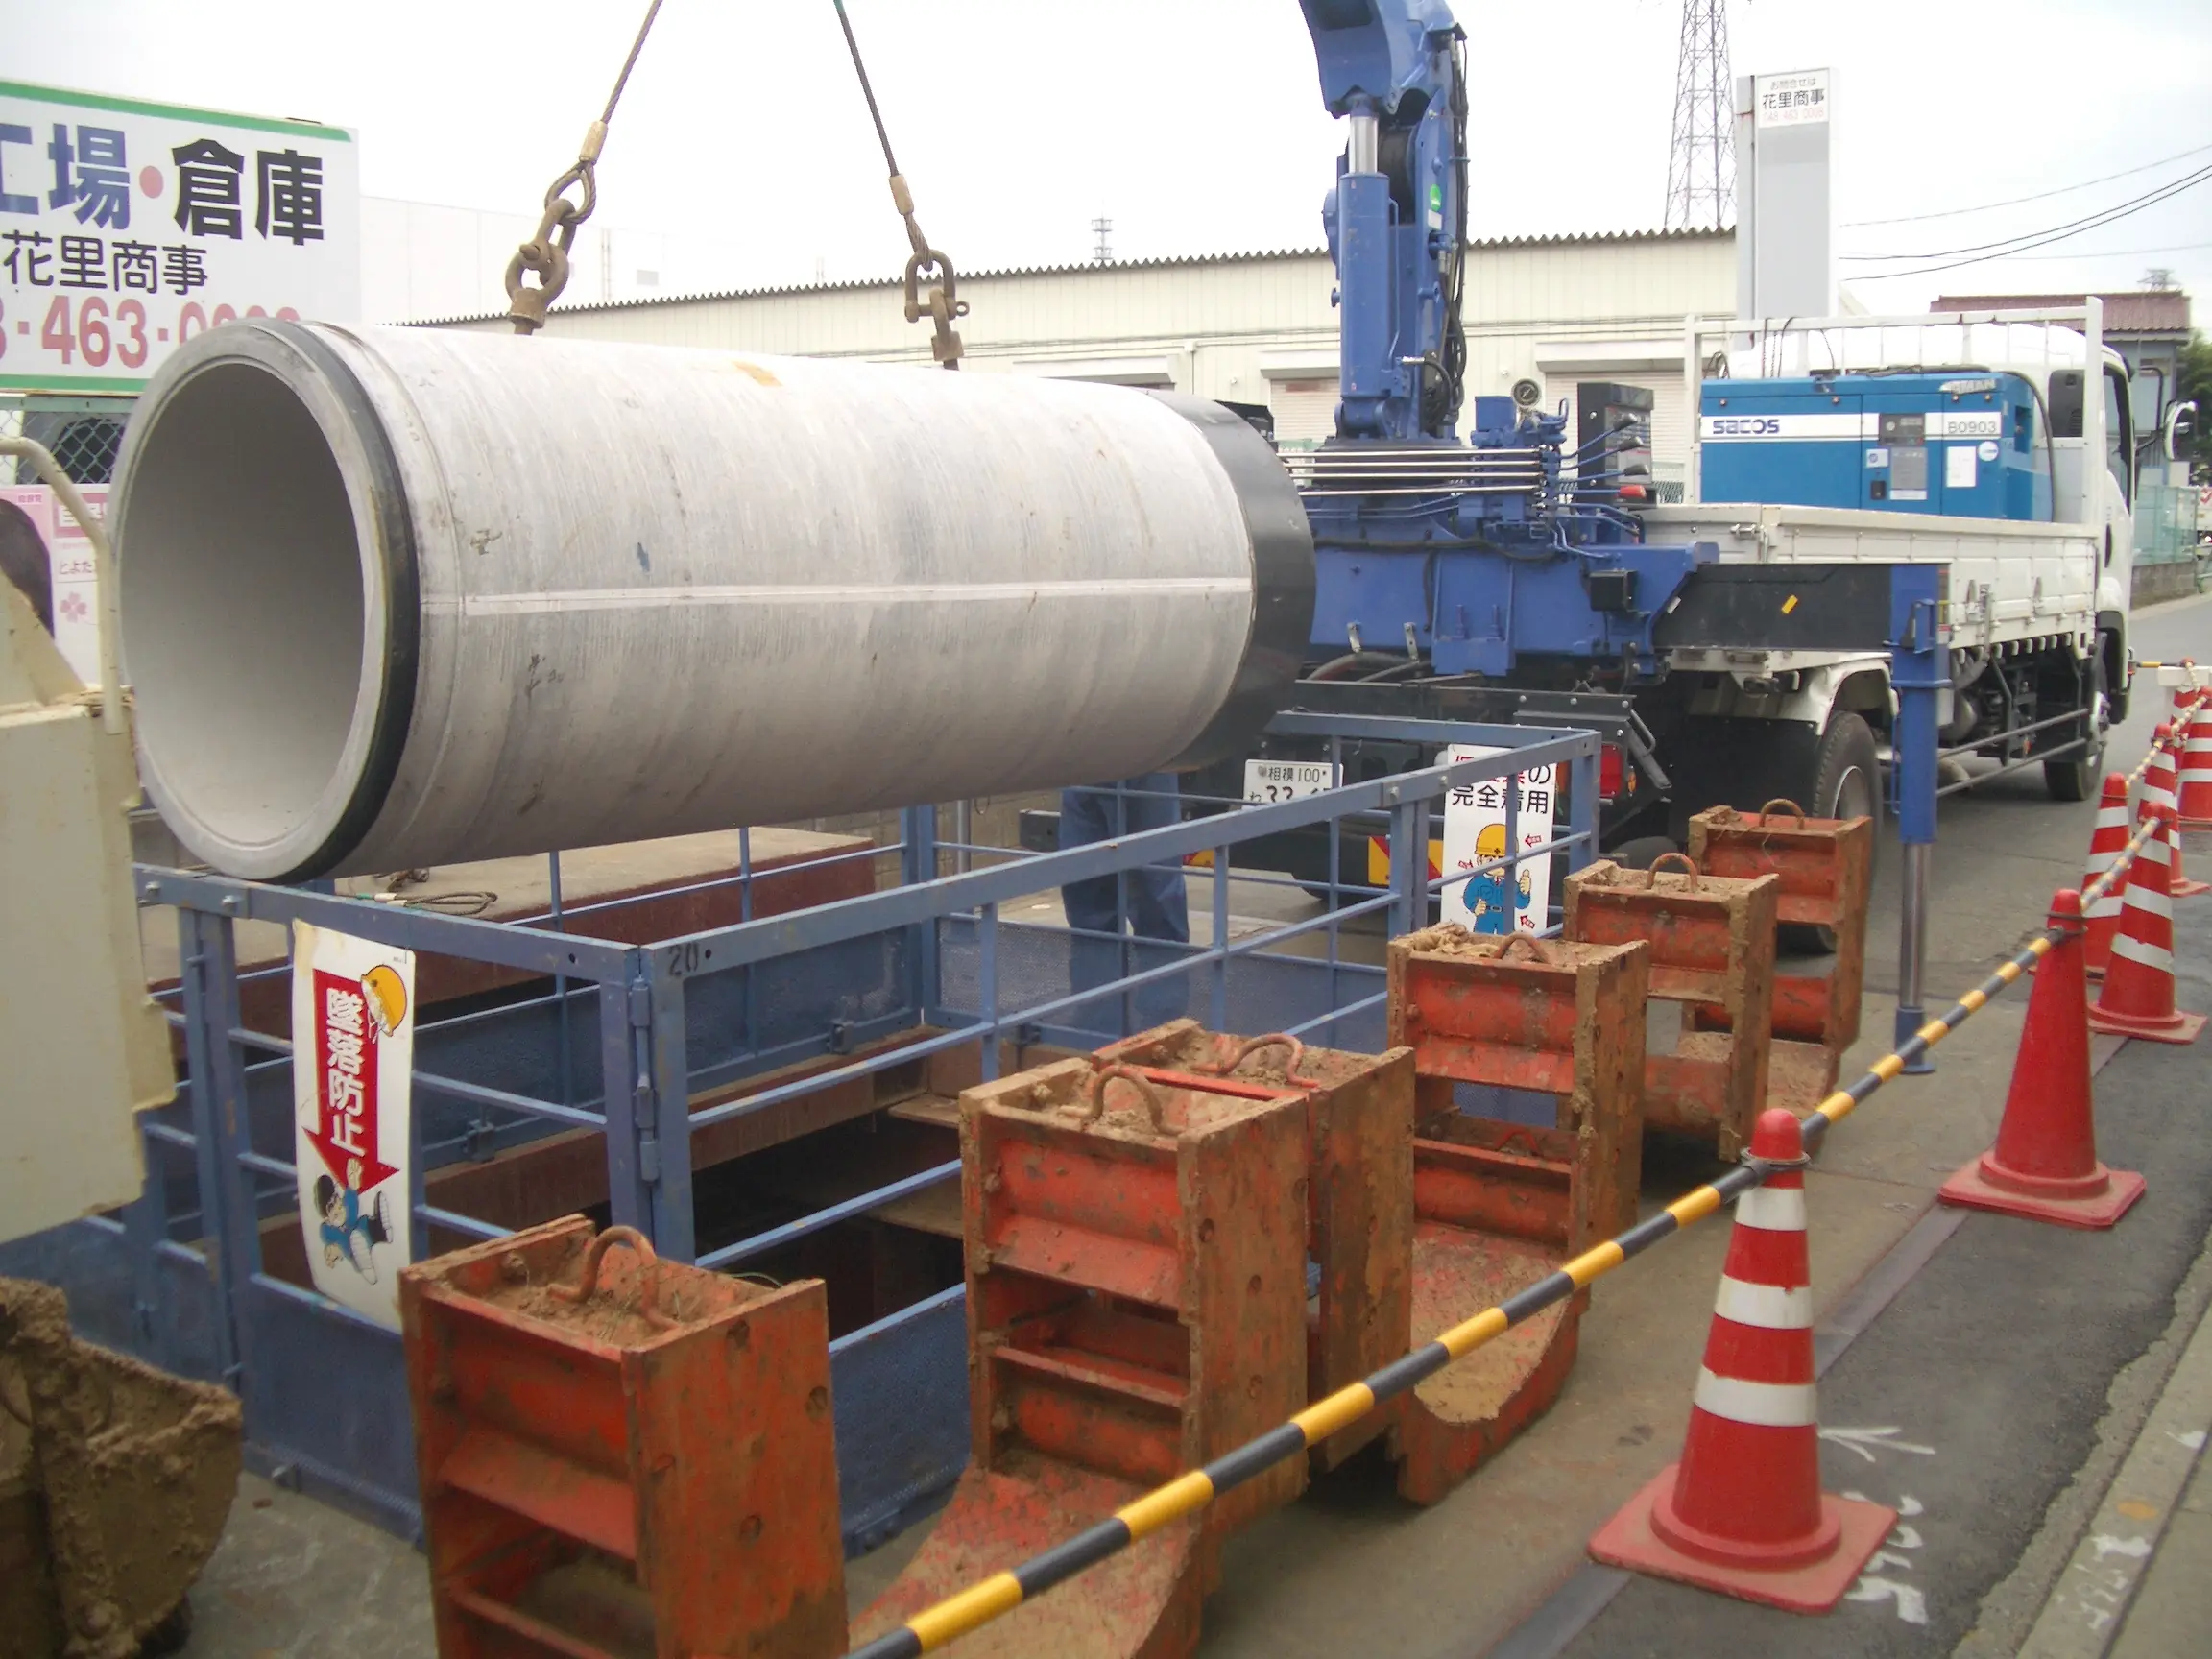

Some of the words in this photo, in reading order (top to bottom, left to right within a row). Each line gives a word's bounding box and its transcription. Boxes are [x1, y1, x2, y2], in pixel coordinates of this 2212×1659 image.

[1762, 88, 1825, 110] 花里商事
[2, 229, 208, 296] 花里商事
[326, 987, 366, 1158] 墜落防止
